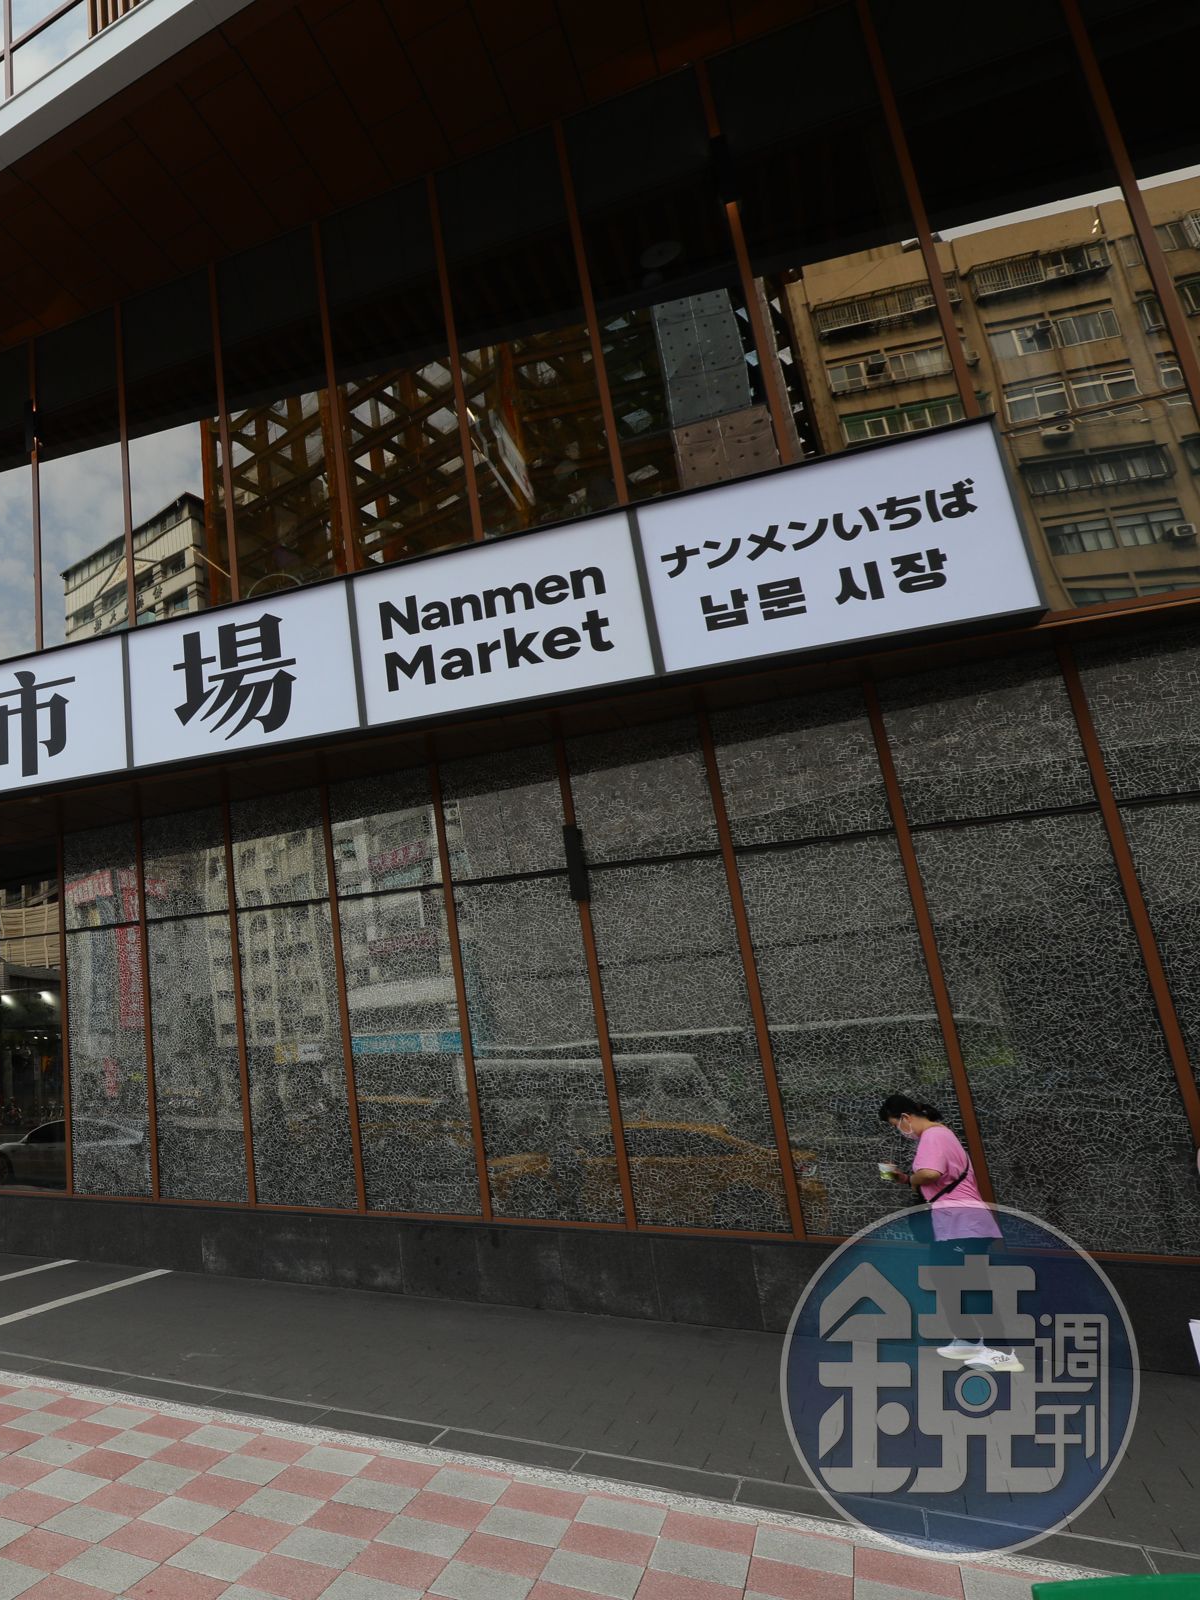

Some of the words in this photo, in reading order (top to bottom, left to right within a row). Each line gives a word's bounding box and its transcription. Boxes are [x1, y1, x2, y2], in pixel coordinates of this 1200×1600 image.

[660, 481, 978, 578] ナンメンいちば
[378, 566, 607, 641] Nanmen
[700, 576, 807, 631] 남문
[835, 548, 948, 605] 시장
[384, 609, 615, 693] Market
